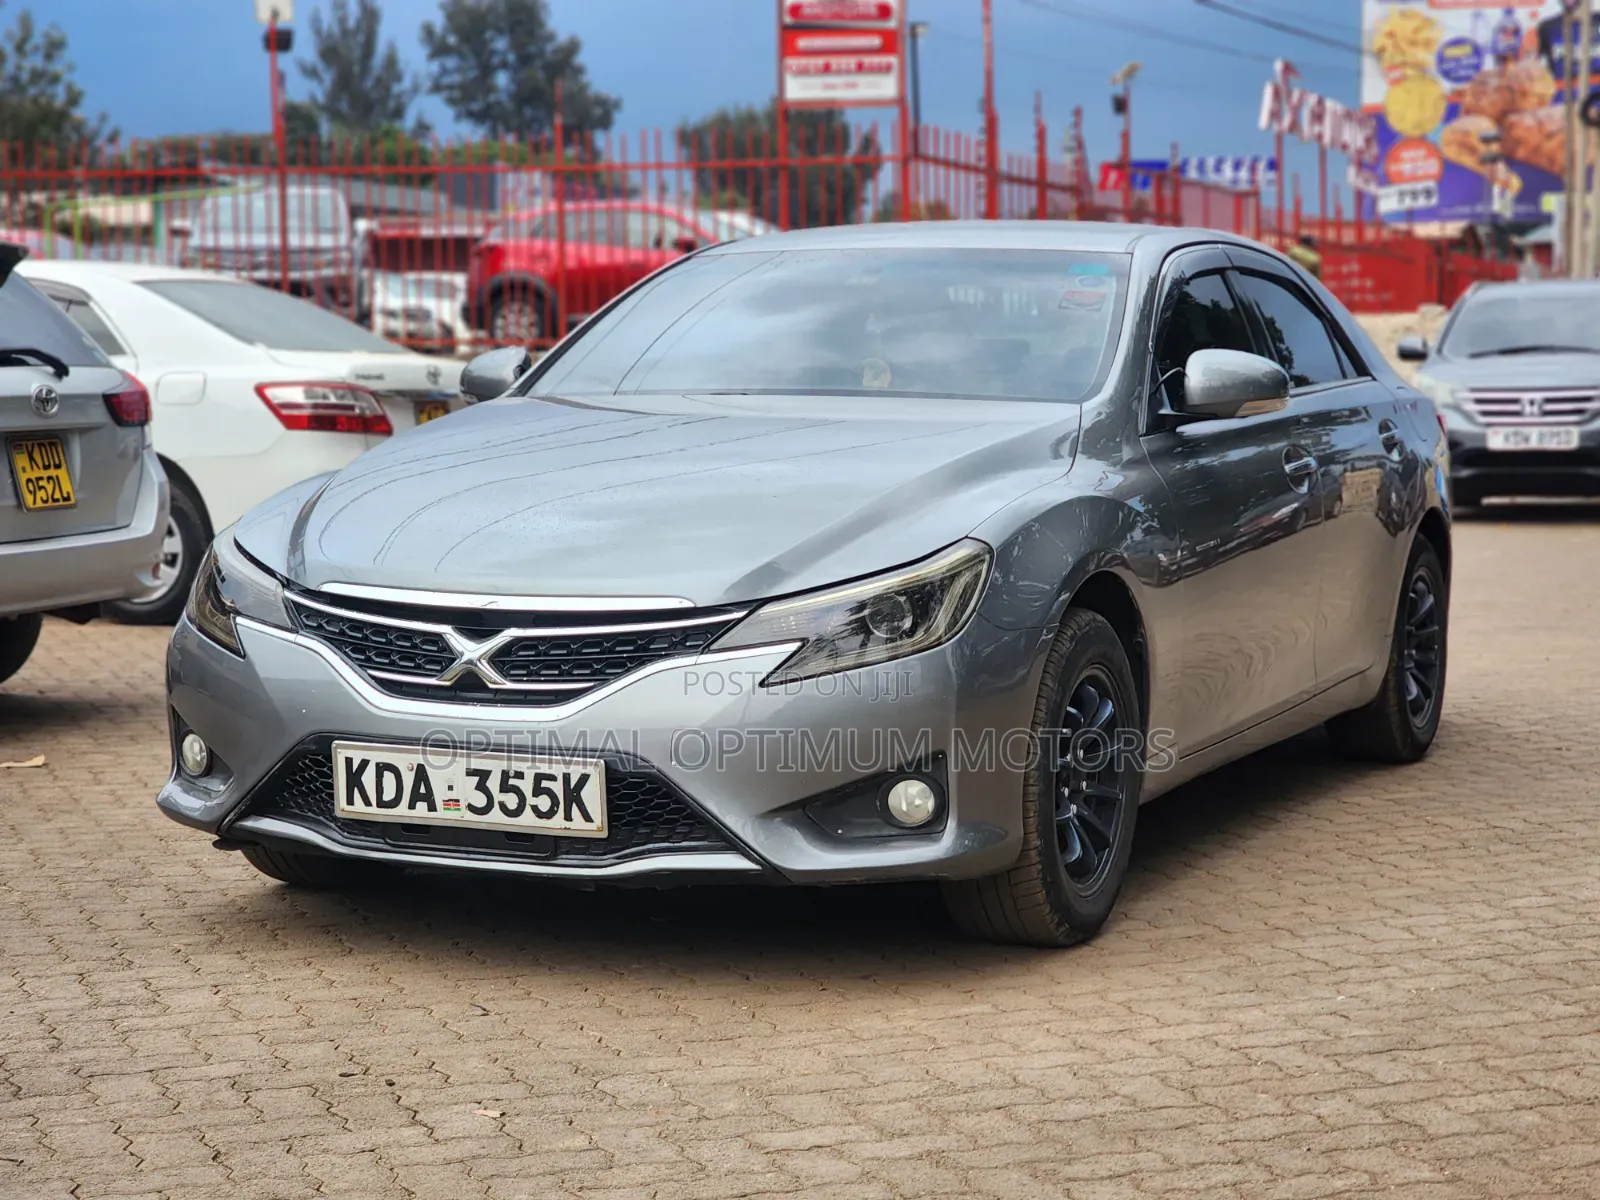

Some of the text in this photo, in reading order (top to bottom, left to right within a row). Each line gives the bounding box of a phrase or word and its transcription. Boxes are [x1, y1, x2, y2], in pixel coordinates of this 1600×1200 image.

[25, 440, 63, 472] KDD
[26, 475, 71, 505] 952L
[344, 756, 595, 823] KDA 355K
